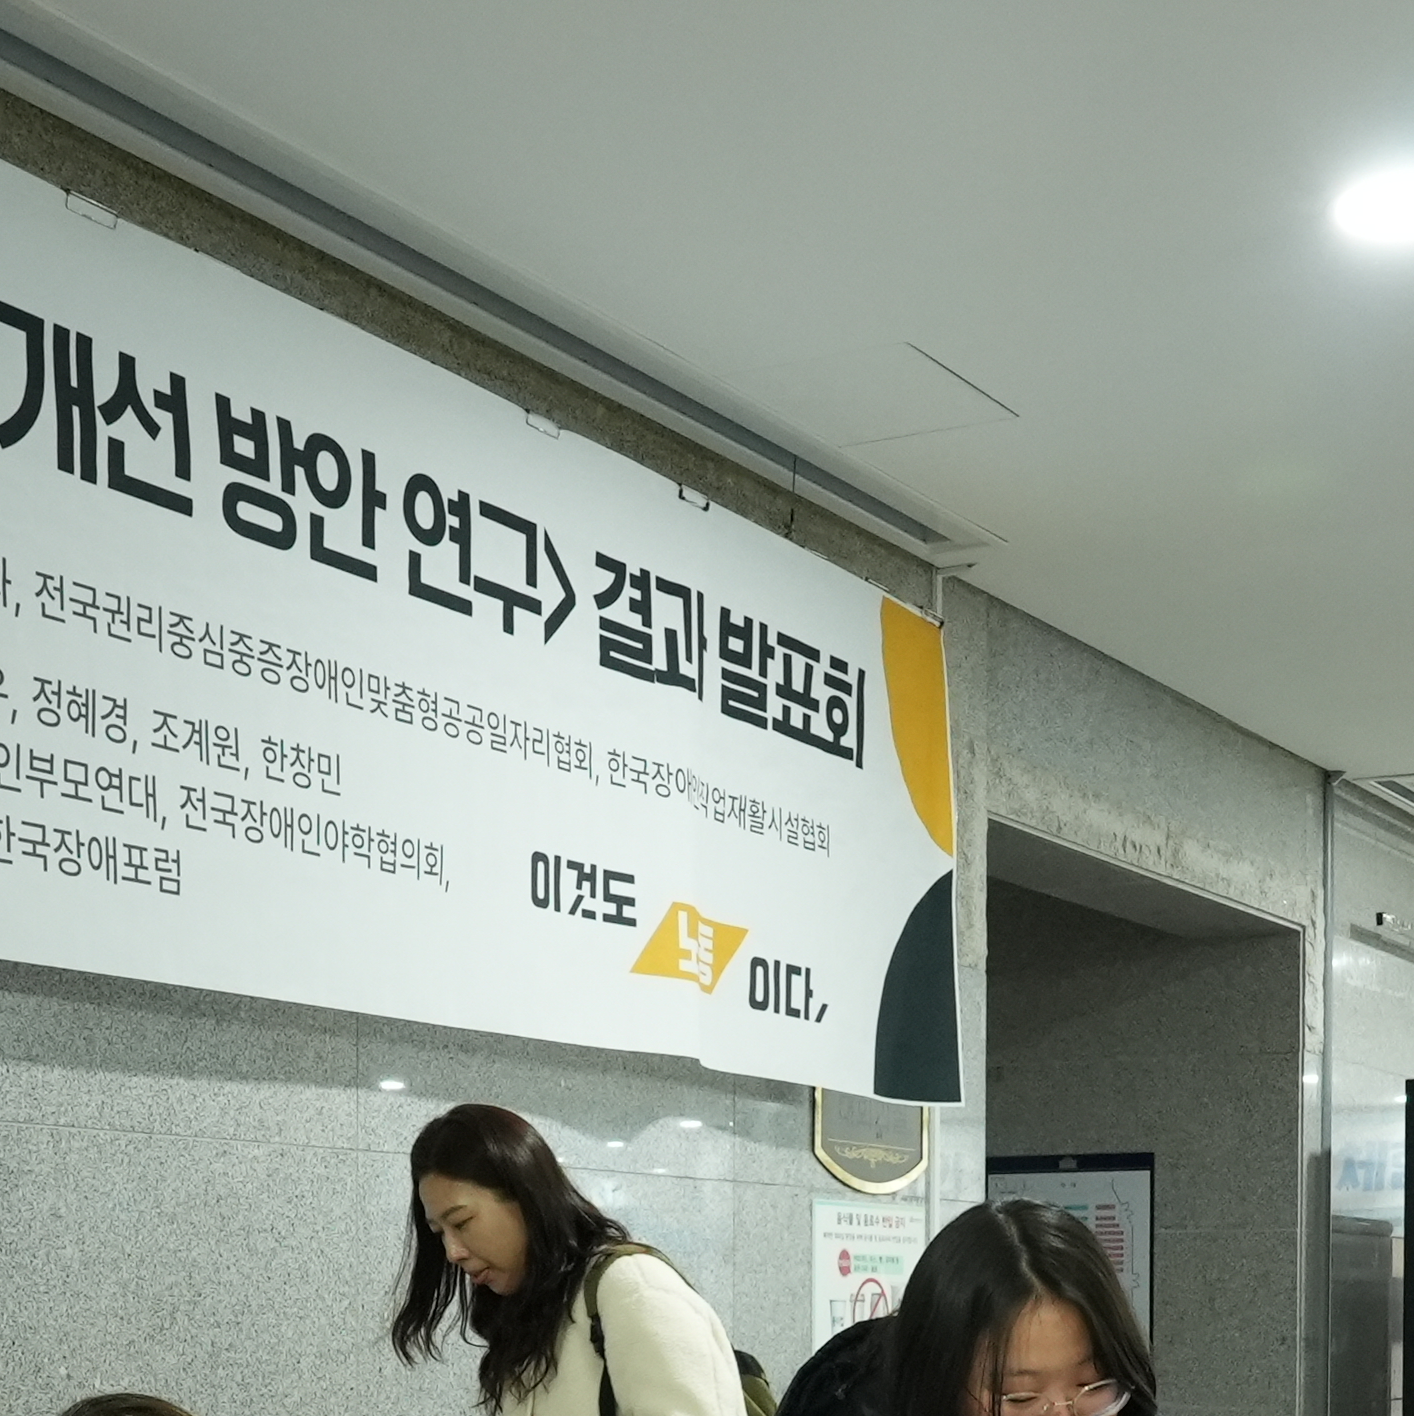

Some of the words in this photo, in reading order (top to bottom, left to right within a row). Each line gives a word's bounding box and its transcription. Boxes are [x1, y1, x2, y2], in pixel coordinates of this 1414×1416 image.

[215, 392, 386, 582] 방안
[593, 551, 707, 701] 결과
[719, 606, 865, 769] 발표회
[32, 676, 138, 754] 정혜경,
[151, 709, 249, 780] 조계원,
[261, 735, 341, 795] 한창민
[35, 570, 600, 787] 전국권리중심중증장애인맞춤형공공일자리협회,
[179, 784, 450, 893] 전국장애인야학협의회,
[530, 850, 637, 927] 이것도
